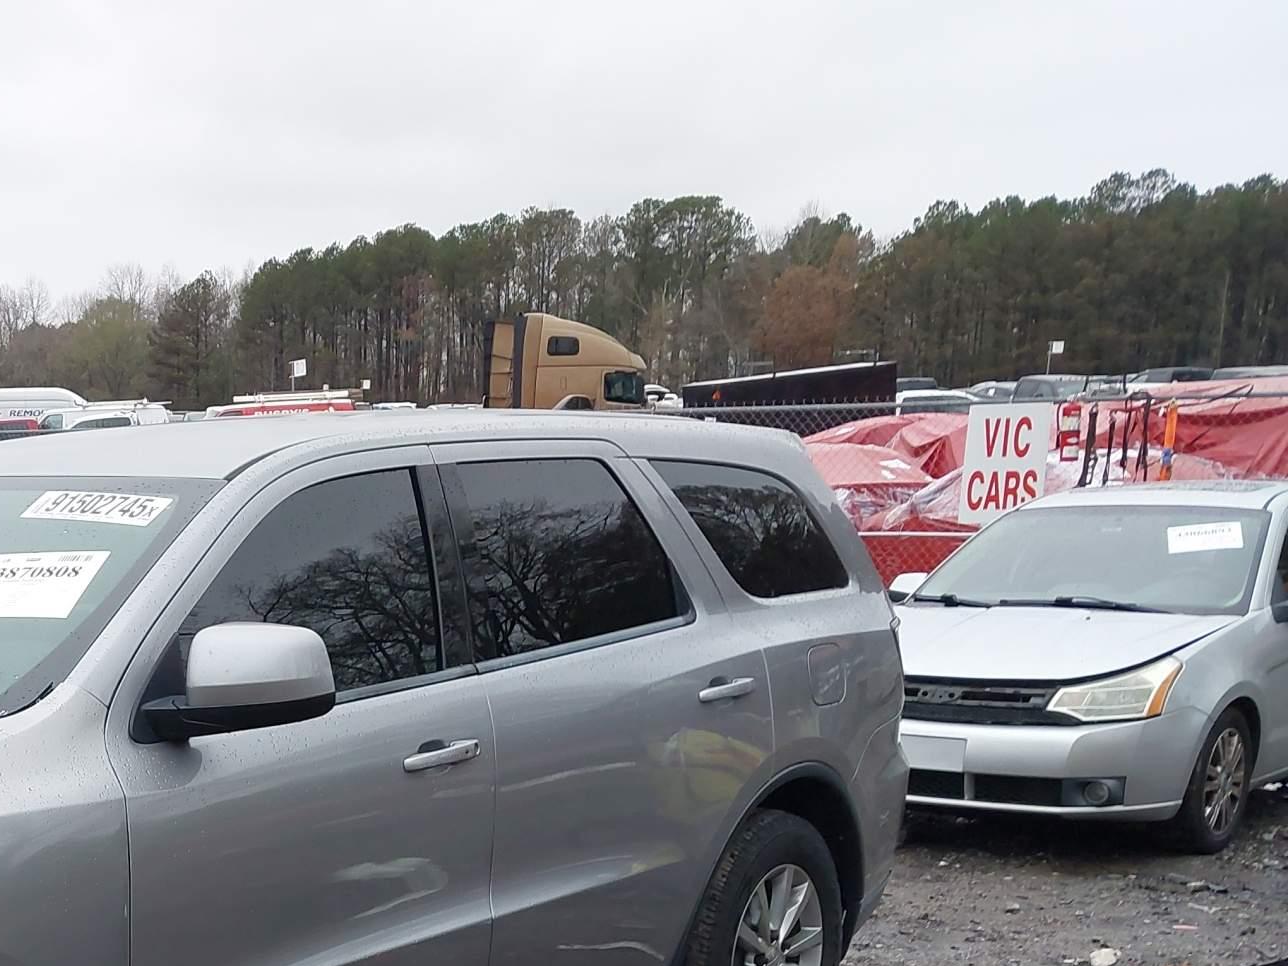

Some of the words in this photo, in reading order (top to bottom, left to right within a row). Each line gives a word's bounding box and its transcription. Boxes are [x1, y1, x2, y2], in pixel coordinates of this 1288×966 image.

[9, 409, 44, 417] REMO
[984, 415, 1033, 458] VIC
[966, 469, 1039, 511] CARS
